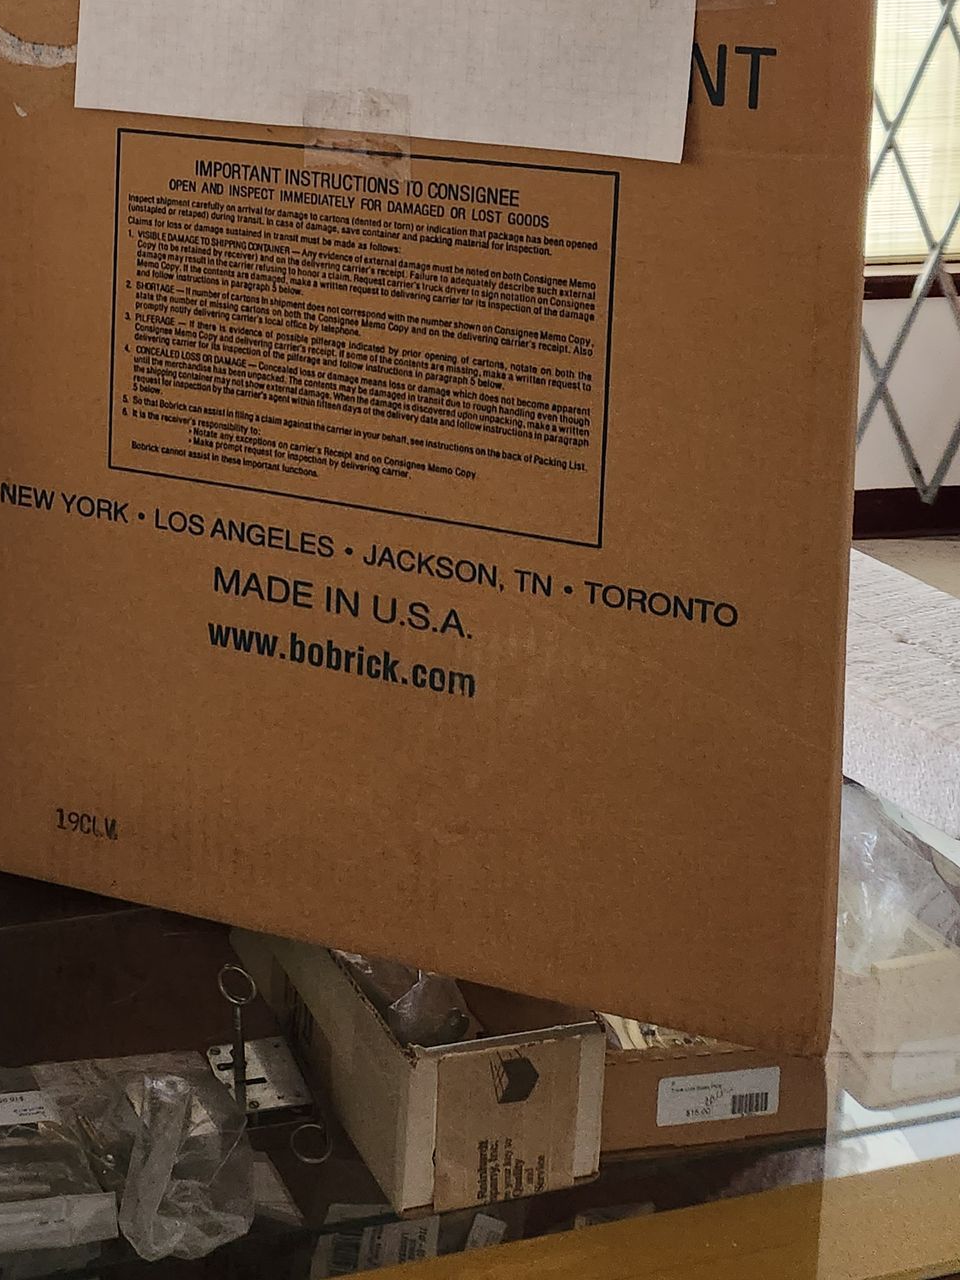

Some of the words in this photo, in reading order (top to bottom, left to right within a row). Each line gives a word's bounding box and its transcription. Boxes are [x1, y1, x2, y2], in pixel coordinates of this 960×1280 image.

[168, 178, 196, 193] OPEN
[201, 181, 223, 195] AND
[228, 184, 274, 200] INSPECT
[279, 189, 355, 209] IMMEDIATELY
[360, 197, 381, 212] FOR
[387, 200, 444, 218] DAMAGED
[450, 206, 466, 220] OR
[471, 208, 500, 224] LOST
[507, 211, 549, 228] GOODS
[195, 159, 281, 184] IMPORTANT
[284, 168, 399, 195] INSTRUCTIONS
[406, 179, 423, 198] TO
[427, 181, 519, 207] CONSIGNEE
[127, 216, 152, 227] Claims
[154, 218, 164, 227] for
[166, 220, 182, 229] loss
[193, 223, 223, 235] damage
[225, 226, 262, 238] sustained
[273, 231, 298, 242] transit
[300, 235, 319, 245] must
[322, 237, 332, 246] be
[333, 238, 355, 249] made
[357, 242, 367, 250] as
[156, 195, 190, 208] shipment
[191, 199, 224, 212] carefully
[237, 204, 263, 215] arrival
[264, 207, 275, 216] for
[276, 208, 308, 221] damage
[309, 212, 317, 221] to
[319, 213, 349, 224] cartons
[351, 216, 381, 228] (dented
[393, 221, 414, 232] torn)
[426, 224, 467, 236] indication
[469, 228, 486, 238] that
[487, 230, 524, 244] package
[525, 234, 541, 244] has
[543, 235, 564, 247] been
[565, 238, 598, 252] opened
[168, 208, 176, 216] or
[210, 211, 235, 223] during
[266, 217, 273, 225] In
[275, 219, 293, 228] case
[295, 220, 303, 229] of
[341, 226, 360, 235] save
[361, 228, 400, 239] container
[402, 231, 417, 241] and
[419, 233, 453, 247] packing
[454, 236, 489, 249] material
[491, 240, 503, 250] for
[147, 411, 159, 420] the
[160, 412, 196, 426] receiver's
[197, 418, 248, 435] responsibility
[131, 440, 159, 453] Bobrick
[160, 445, 186, 457] cannot
[187, 449, 210, 460] assist
[211, 452, 219, 461] in
[220, 454, 241, 465] these
[242, 457, 280, 473] important
[192, 436, 213, 448] Make
[215, 440, 242, 453] prompt
[243, 445, 272, 458] request
[274, 449, 285, 458] for
[287, 451, 327, 467] inspection
[328, 457, 339, 469] by
[340, 459, 380, 475] delivering
[193, 427, 217, 438] Notate
[219, 432, 233, 442] any
[235, 434, 276, 449] exceptions
[277, 441, 288, 450] on
[323, 446, 352, 460] Receipt
[354, 452, 369, 462] and
[371, 455, 382, 464] on
[383, 456, 426, 472] Consignee
[427, 462, 453, 475] Memo
[454, 466, 476, 479] Copy
[0, 482, 55, 510] NEW
[61, 492, 129, 524] YORK
[154, 508, 205, 536] LOS
[210, 518, 335, 558] ANGELES
[363, 544, 505, 594] JACKSON,
[514, 569, 553, 598] TN
[584, 580, 739, 628] TORONTO
[214, 566, 314, 609] MADE
[326, 586, 360, 618] IN
[373, 594, 474, 640] U.S.A.
[208, 622, 476, 698] www.bobrick.com
